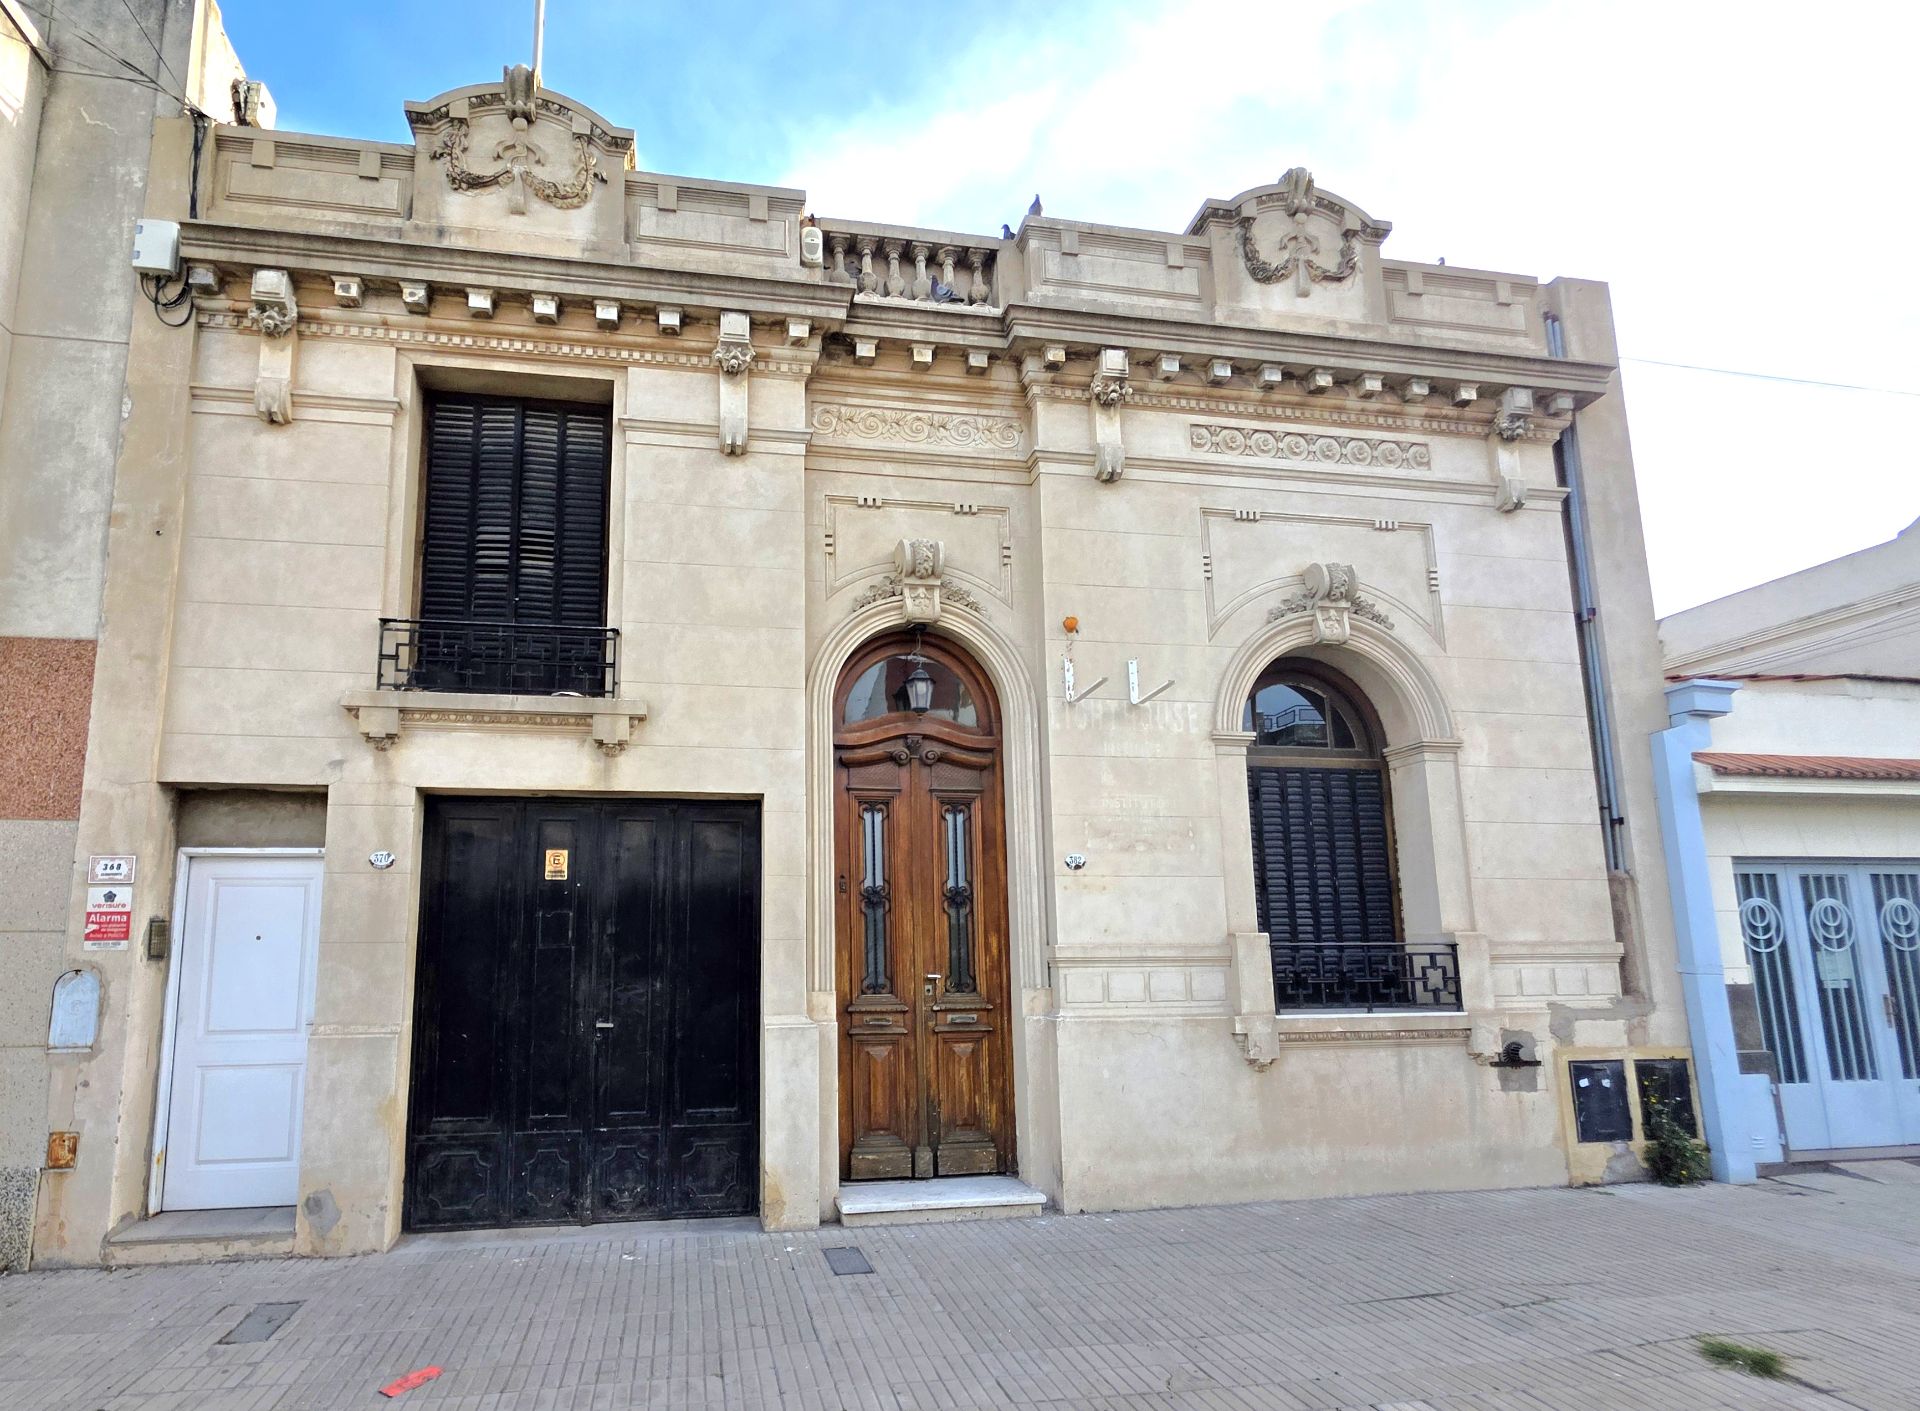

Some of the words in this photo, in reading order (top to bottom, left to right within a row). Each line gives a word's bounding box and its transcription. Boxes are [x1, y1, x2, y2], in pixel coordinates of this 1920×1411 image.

[373, 853, 389, 863] 370
[1069, 856, 1082, 864] 382
[102, 863, 122, 871] 368
[89, 913, 127, 923] Alarma
